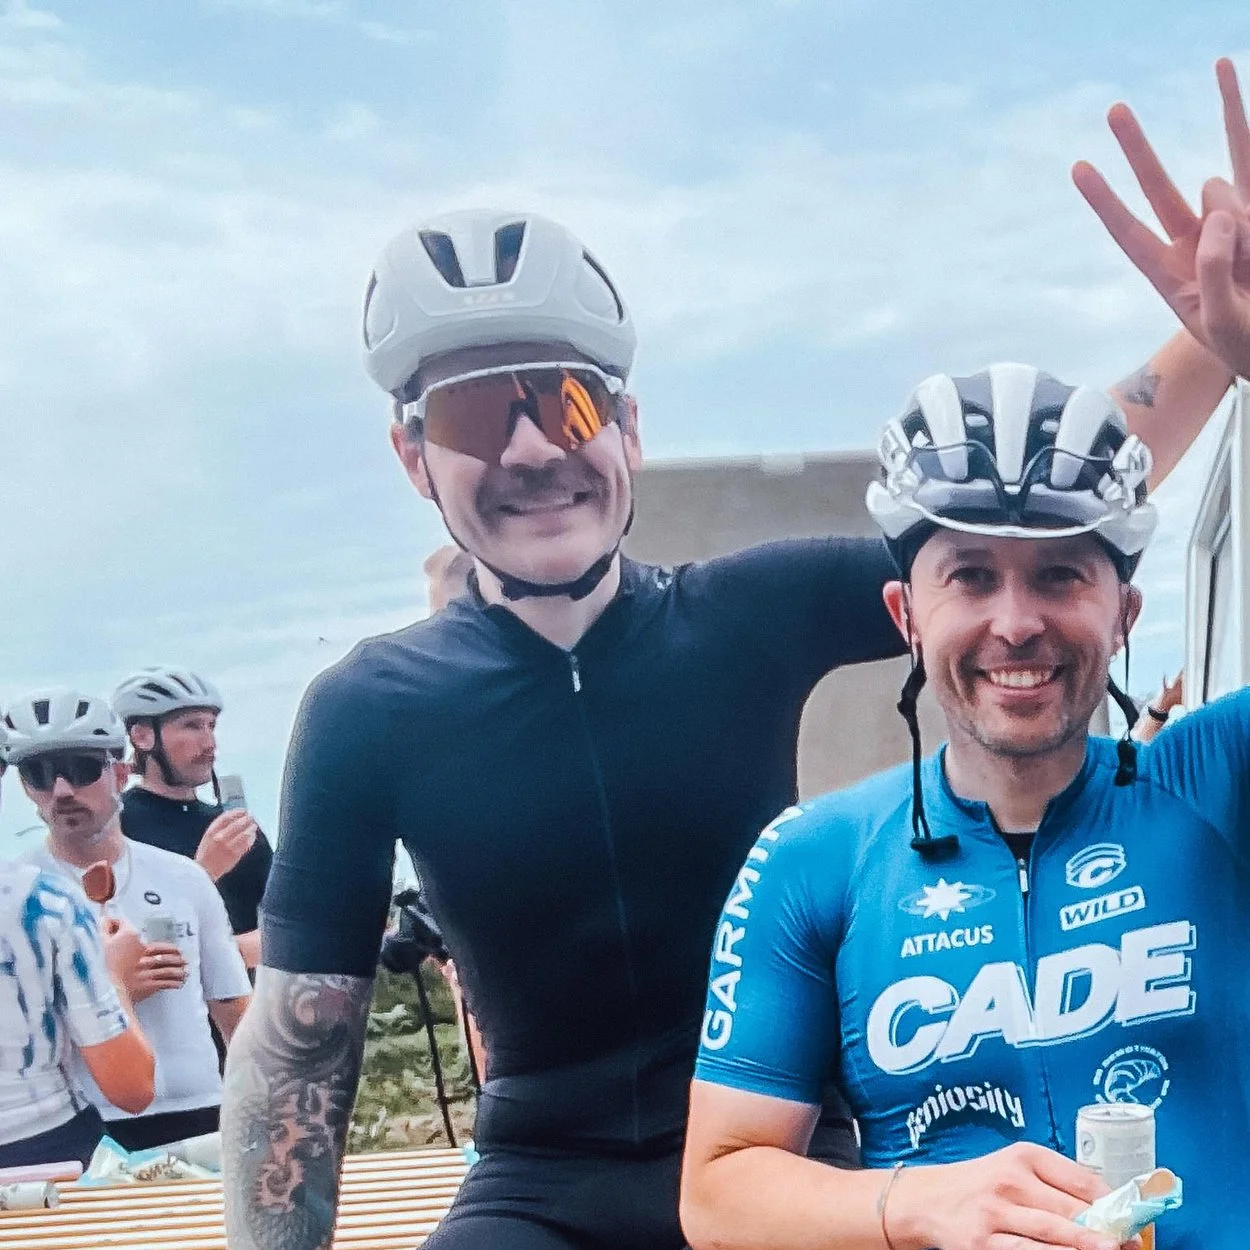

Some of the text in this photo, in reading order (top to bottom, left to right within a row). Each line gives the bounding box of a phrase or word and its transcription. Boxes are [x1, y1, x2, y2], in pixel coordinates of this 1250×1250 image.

[1063, 891, 1140, 926] WILD
[901, 925, 994, 958] ATTACUS
[867, 920, 1197, 1075] CADE
